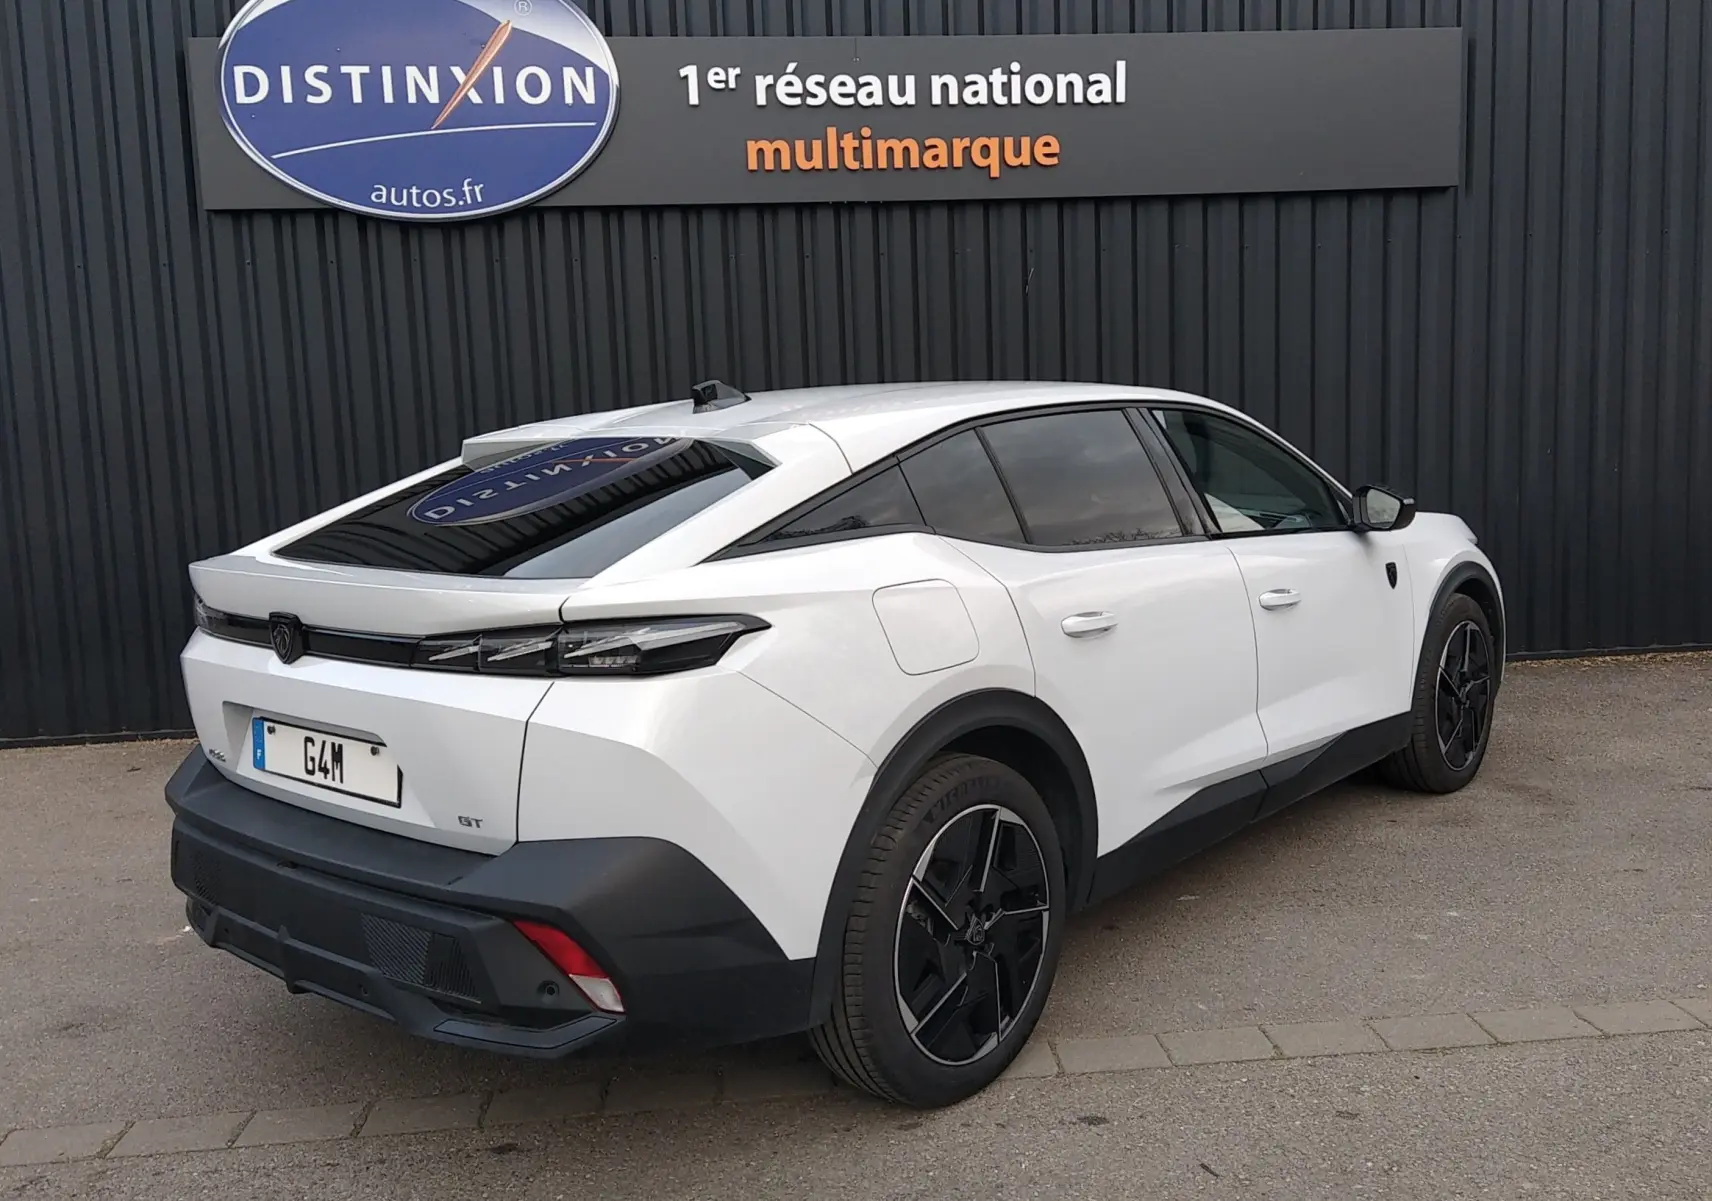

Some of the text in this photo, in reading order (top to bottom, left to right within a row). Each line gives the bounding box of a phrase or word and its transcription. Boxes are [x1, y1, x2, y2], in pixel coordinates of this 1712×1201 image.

[232, 64, 597, 105] DISTINXION
[754, 61, 917, 106] réseau
[930, 59, 1127, 104] national
[745, 125, 1061, 178] multimarque
[370, 178, 485, 208] autos.fr
[303, 736, 344, 784] G4M
[457, 815, 483, 829] GT
